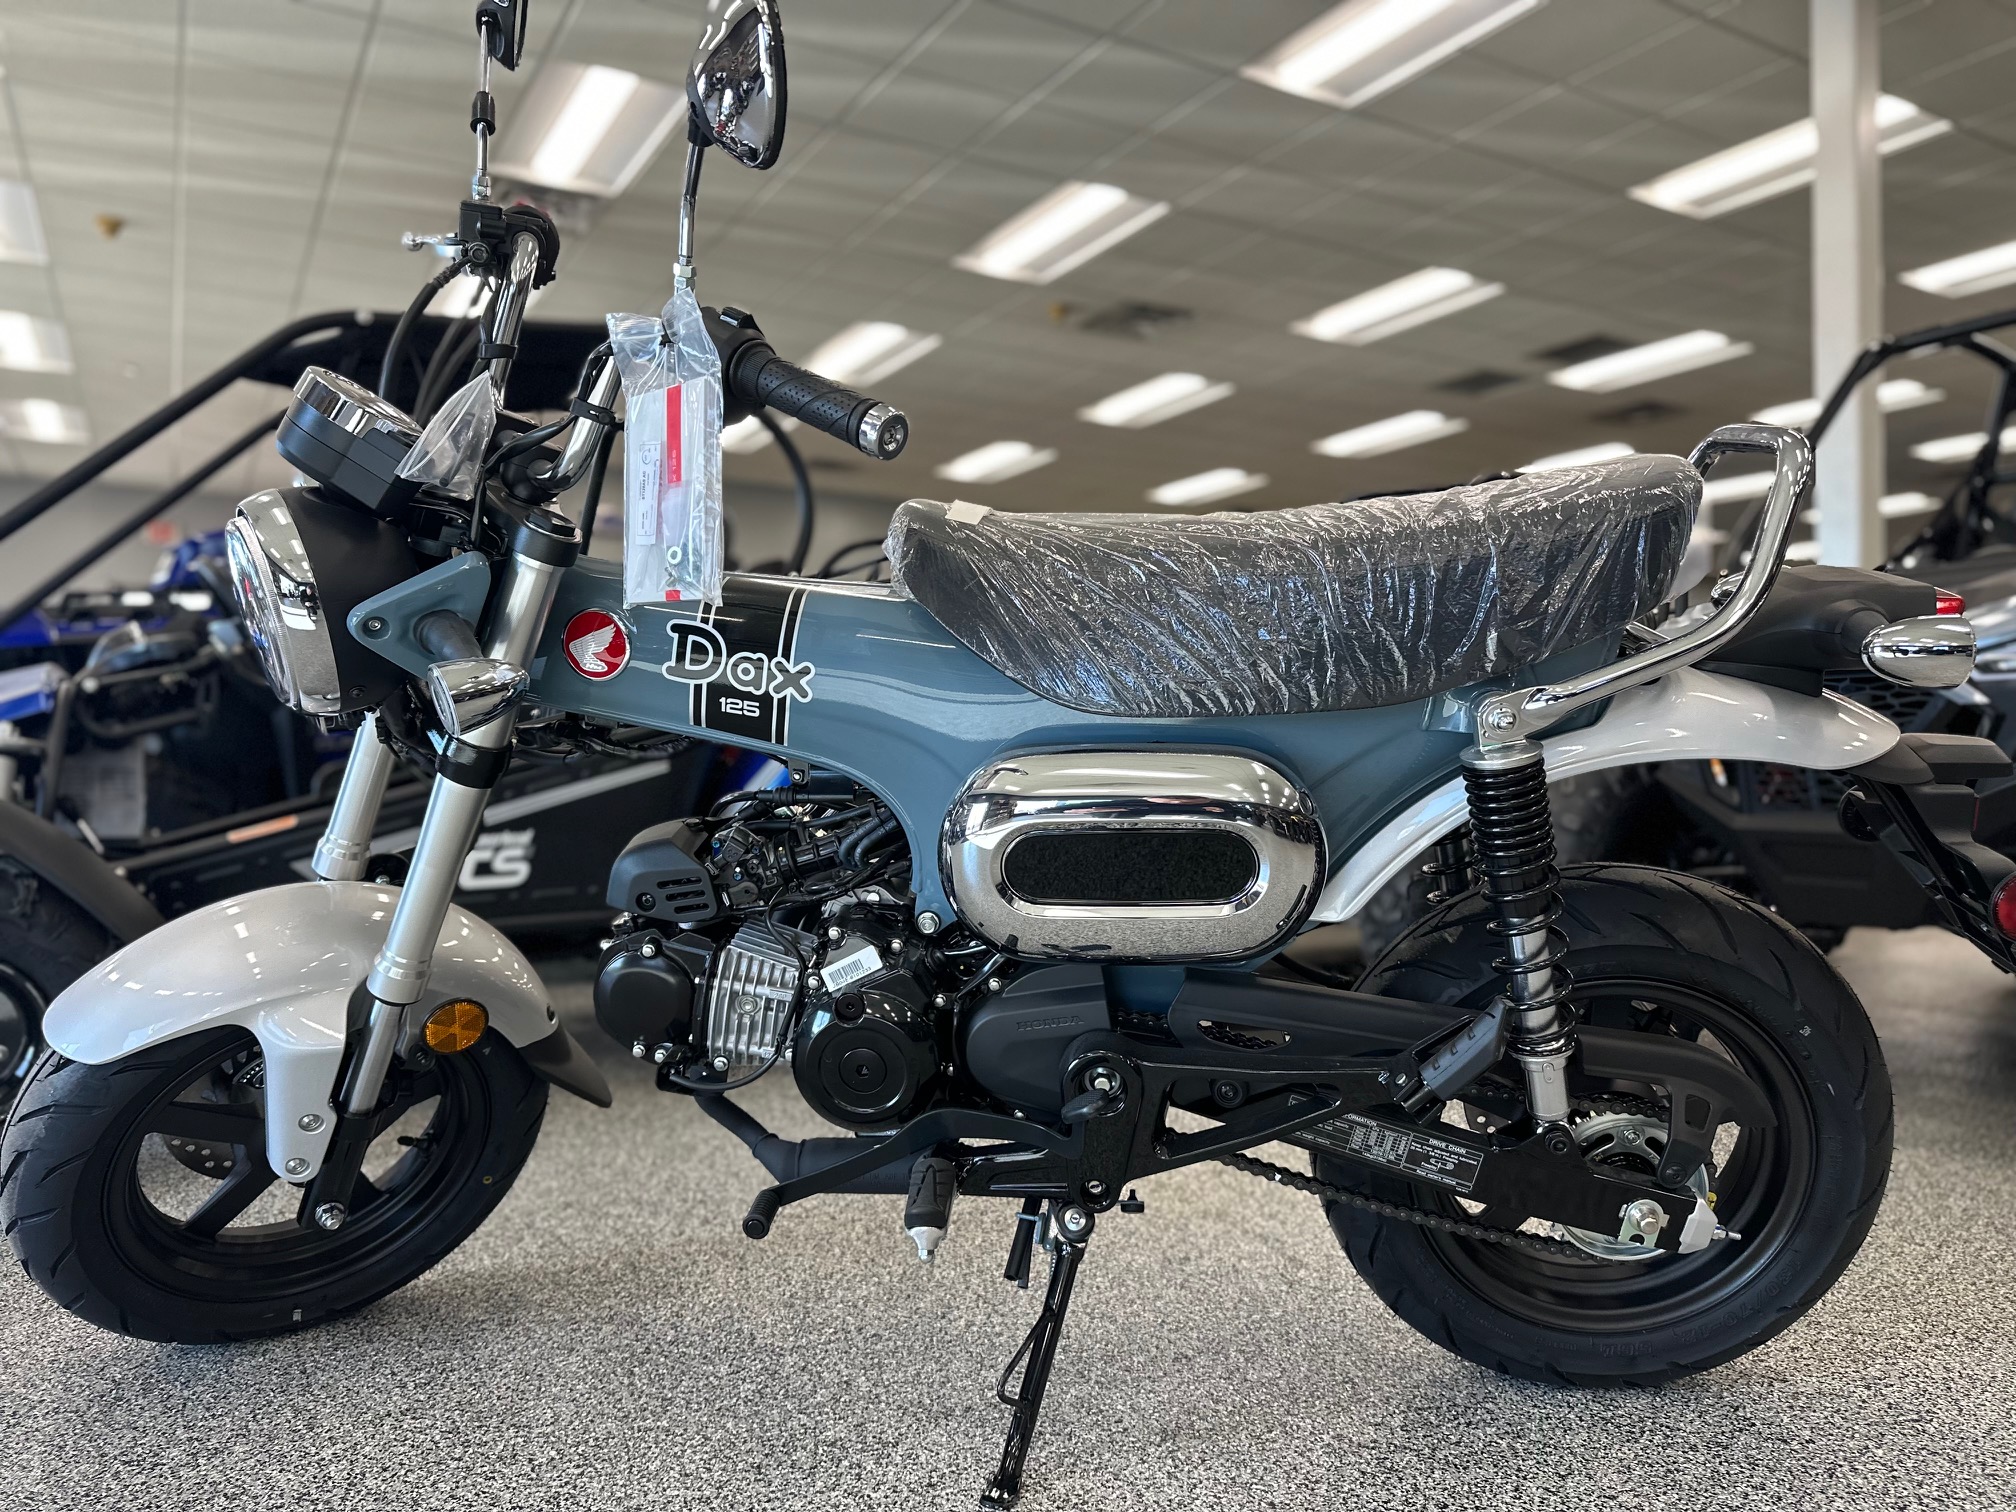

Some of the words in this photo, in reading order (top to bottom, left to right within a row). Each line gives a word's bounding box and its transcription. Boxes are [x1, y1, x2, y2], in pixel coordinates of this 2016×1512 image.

[662, 619, 816, 703] Dax
[719, 697, 760, 717] 125
[1017, 1015, 1085, 1032] HONDA
[1429, 1139, 1446, 1148] DRIVE
[1448, 1144, 1466, 1154] CHAIN
